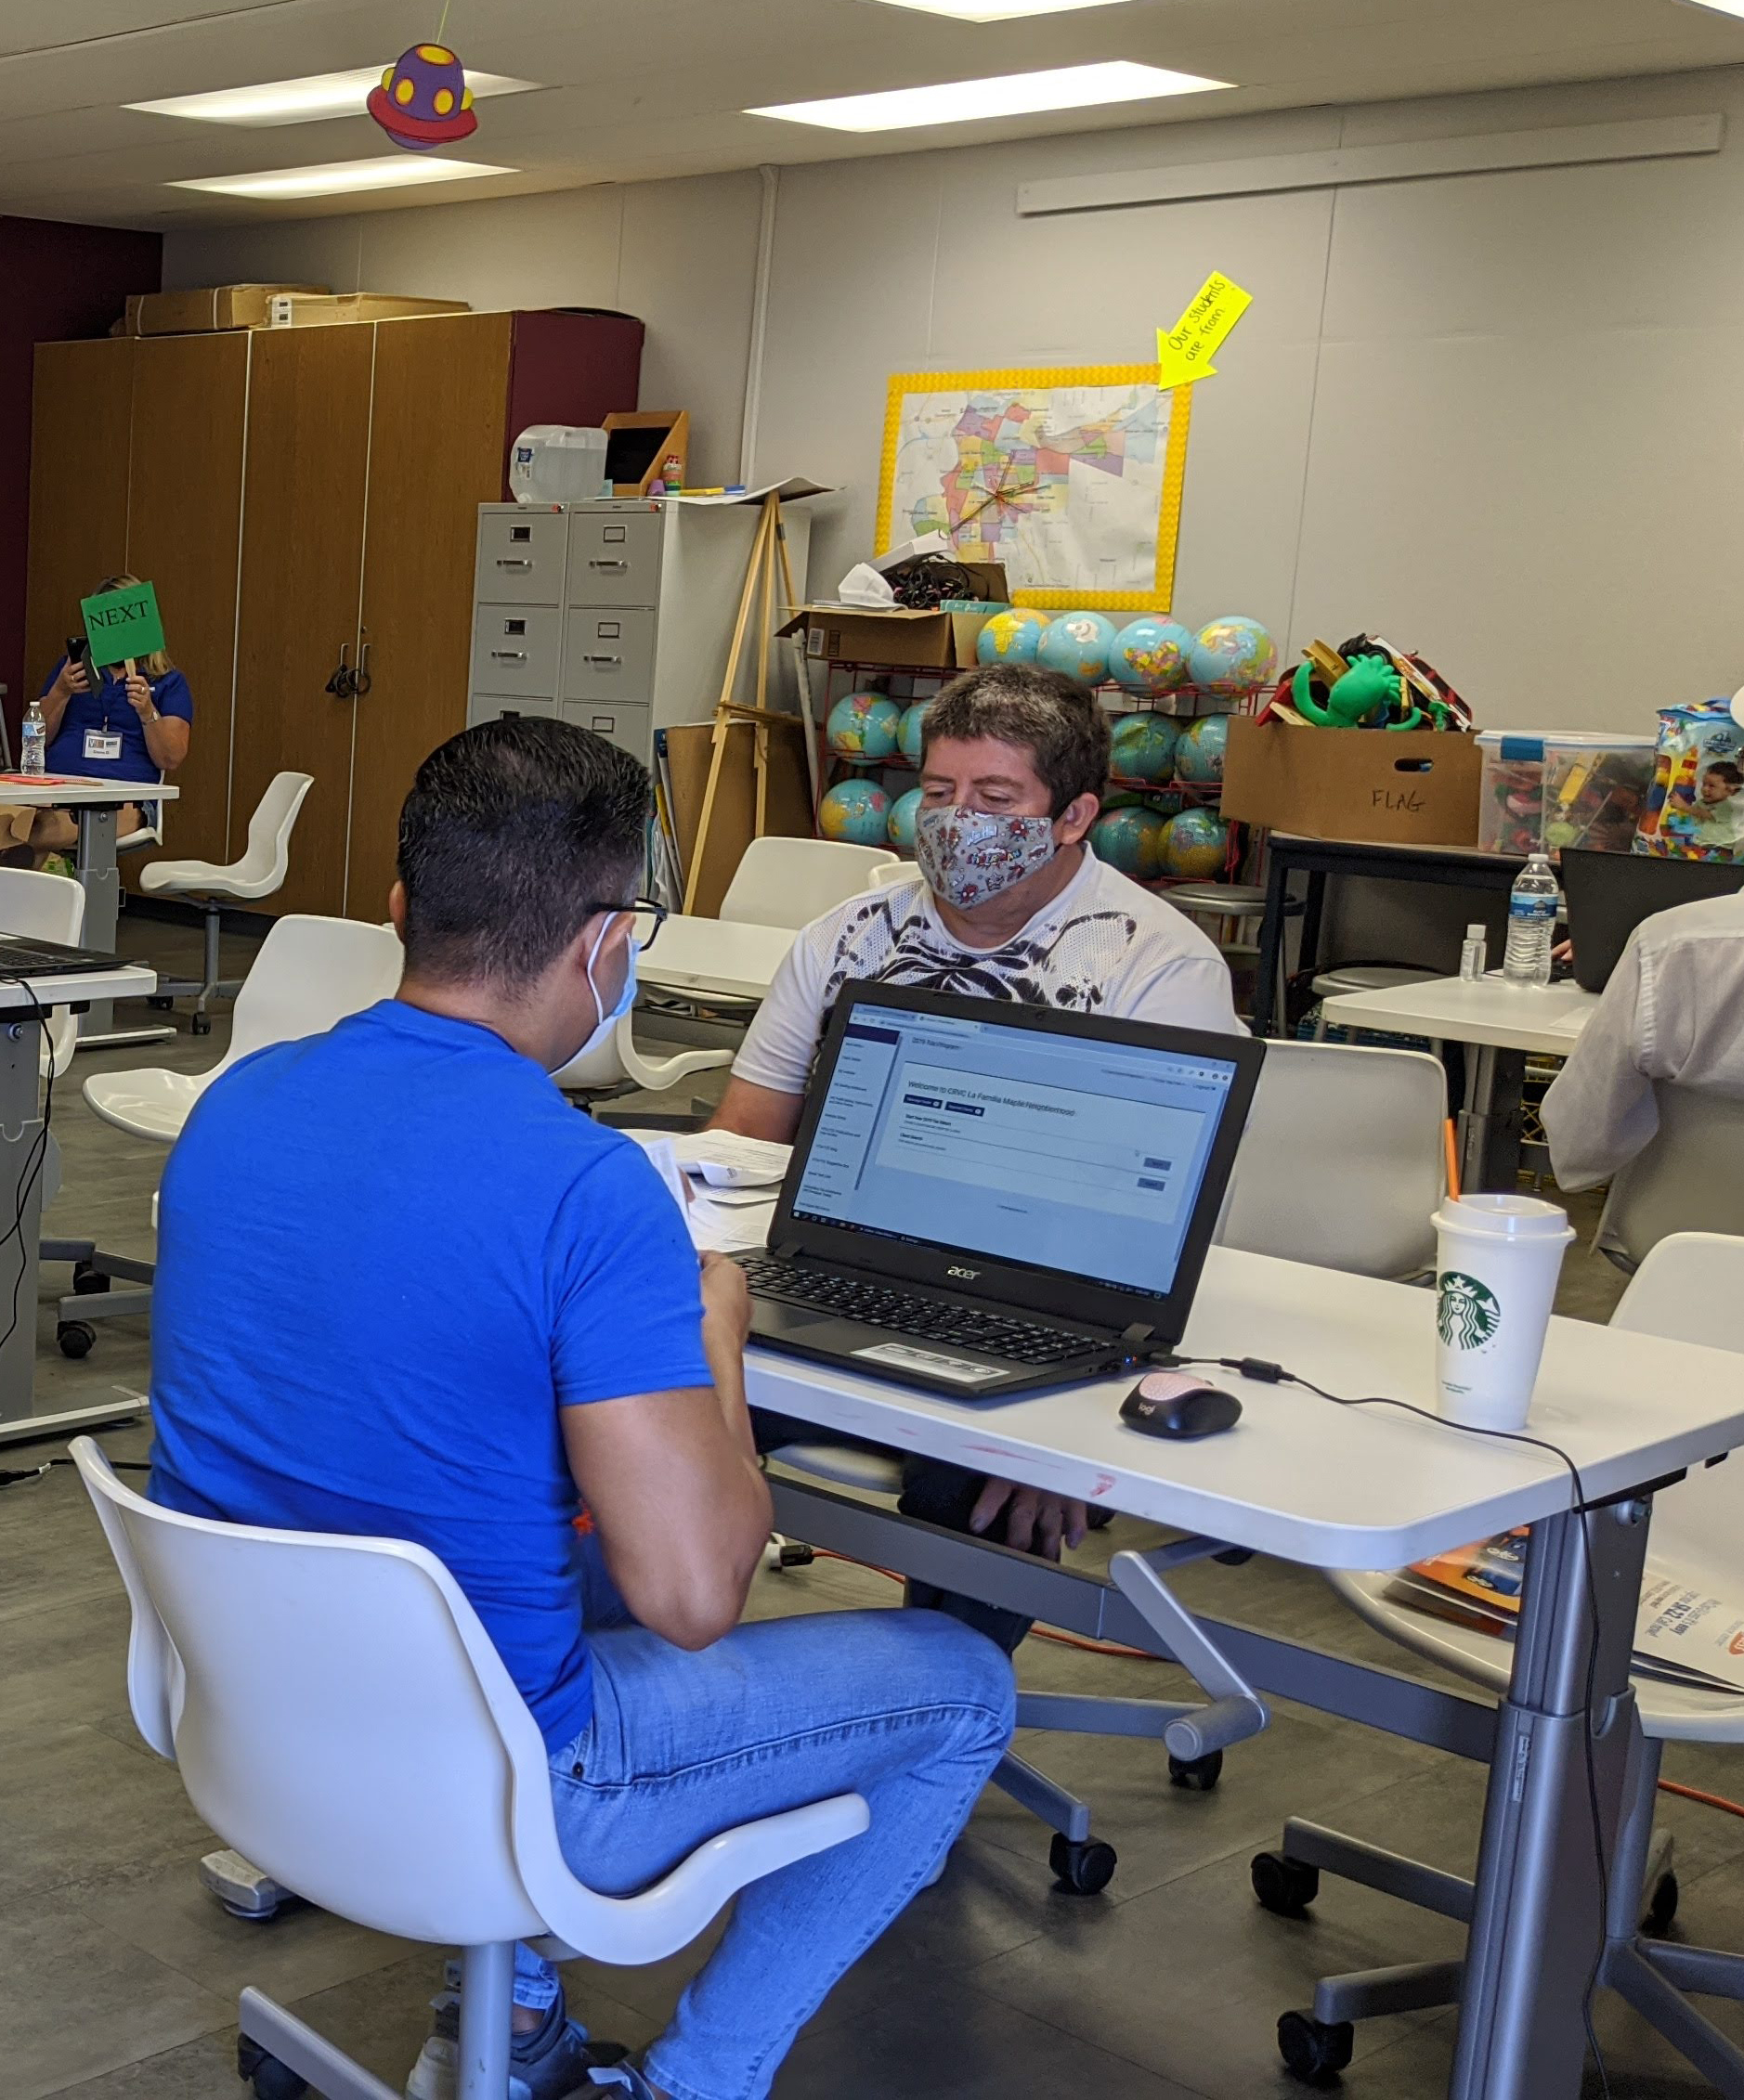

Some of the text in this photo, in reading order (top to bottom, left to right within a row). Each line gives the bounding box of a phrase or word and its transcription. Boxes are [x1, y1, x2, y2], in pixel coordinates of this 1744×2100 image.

[1167, 326, 1192, 351] Our
[1185, 308, 1226, 361] are from
[87, 600, 149, 631] NEXT
[1373, 790, 1426, 812] FLAG
[908, 1080, 939, 1094] Welcome
[939, 1085, 947, 1095] to
[968, 1090, 977, 1099] La
[947, 1265, 981, 1280] acer
[1138, 1402, 1157, 1416] logi
